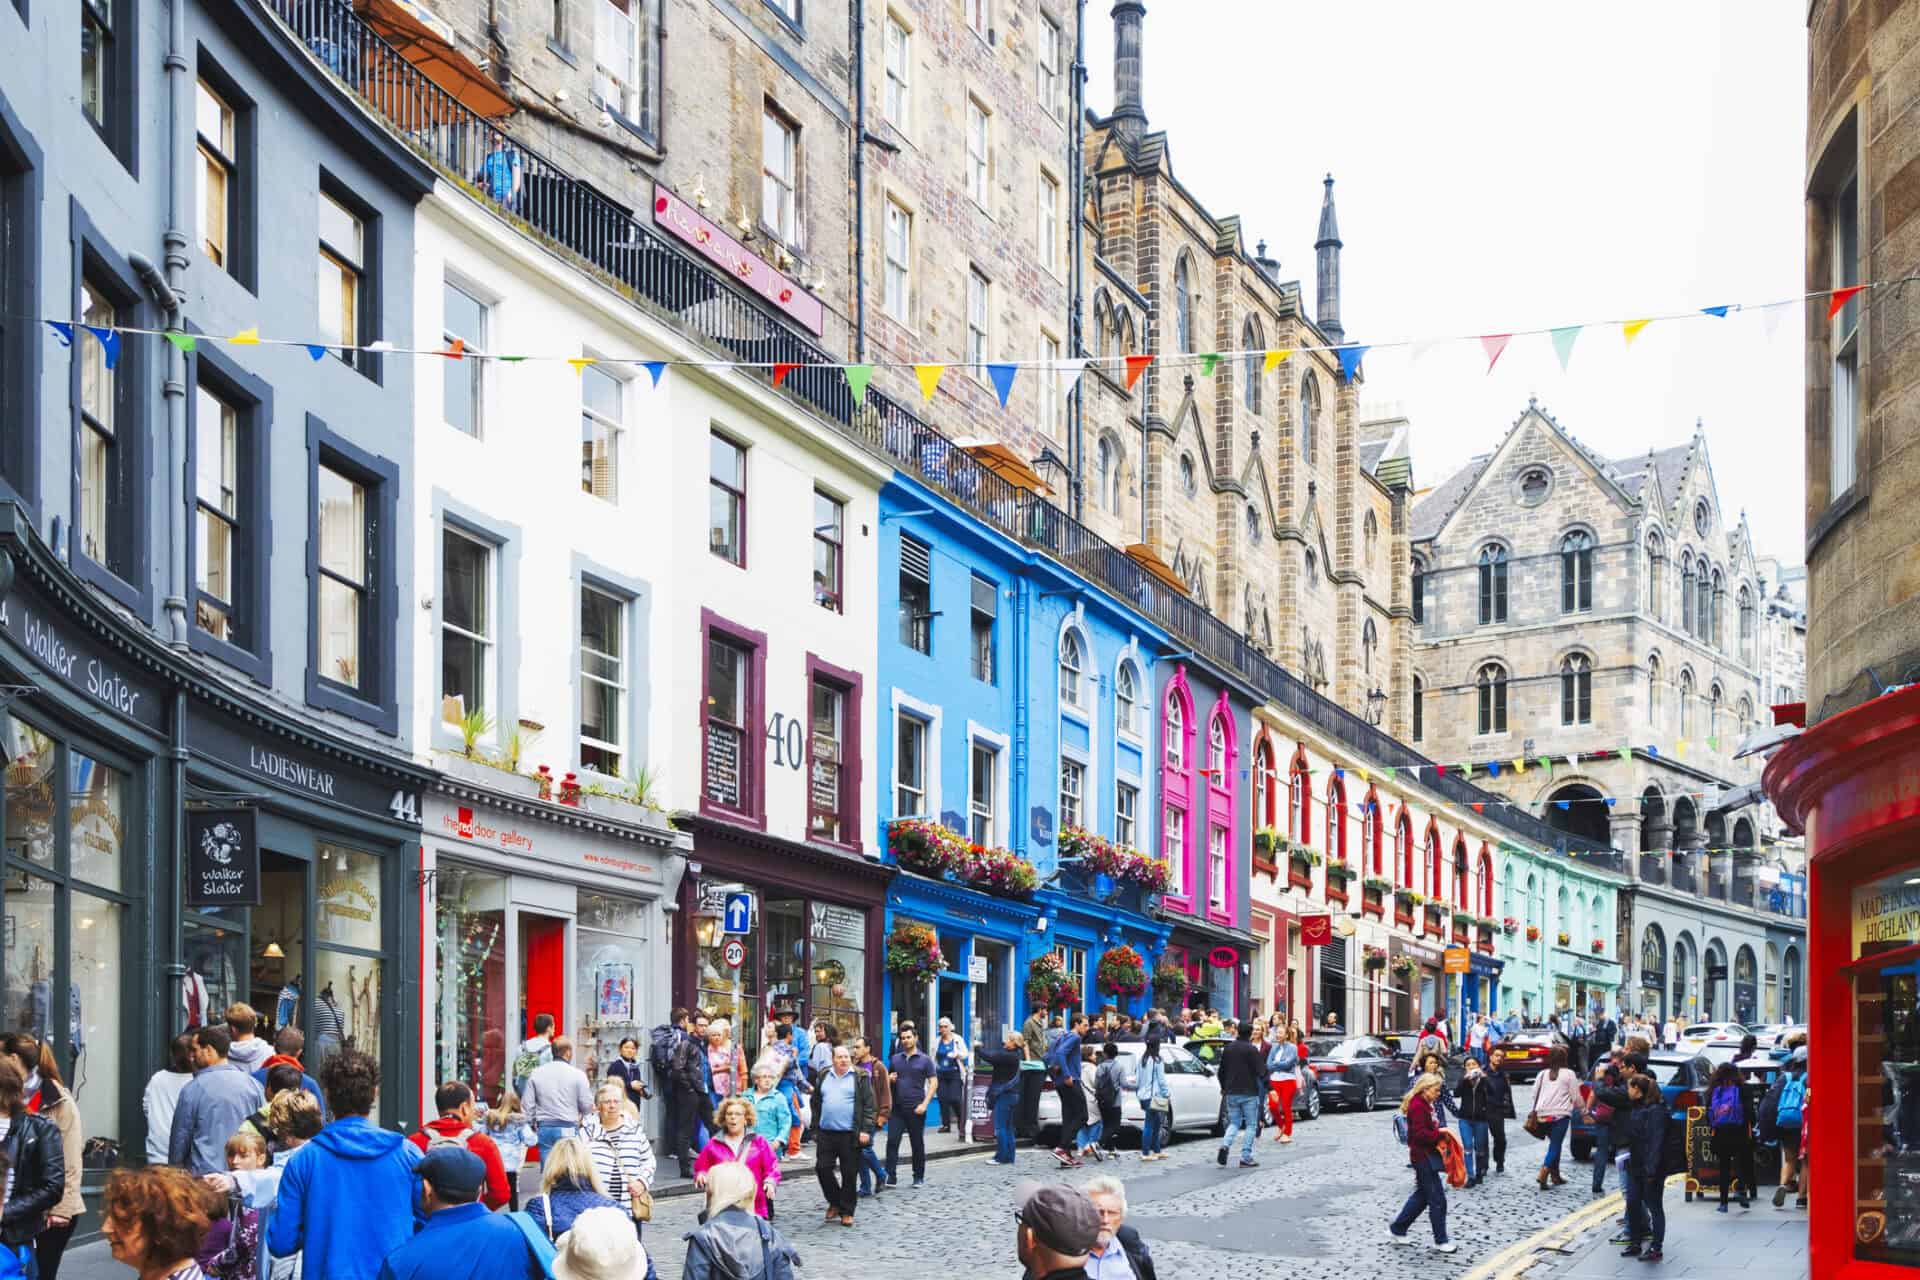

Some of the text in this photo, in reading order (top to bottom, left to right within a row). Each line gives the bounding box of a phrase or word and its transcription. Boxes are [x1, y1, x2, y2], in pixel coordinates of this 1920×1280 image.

[25, 609, 77, 678] Walker
[87, 659, 139, 715] Slater
[767, 712, 803, 771] 40
[250, 745, 335, 796] LADIESWEAR
[458, 818, 473, 834] red
[474, 821, 497, 838] door
[500, 828, 533, 850] gallery
[727, 948, 742, 960] 20
